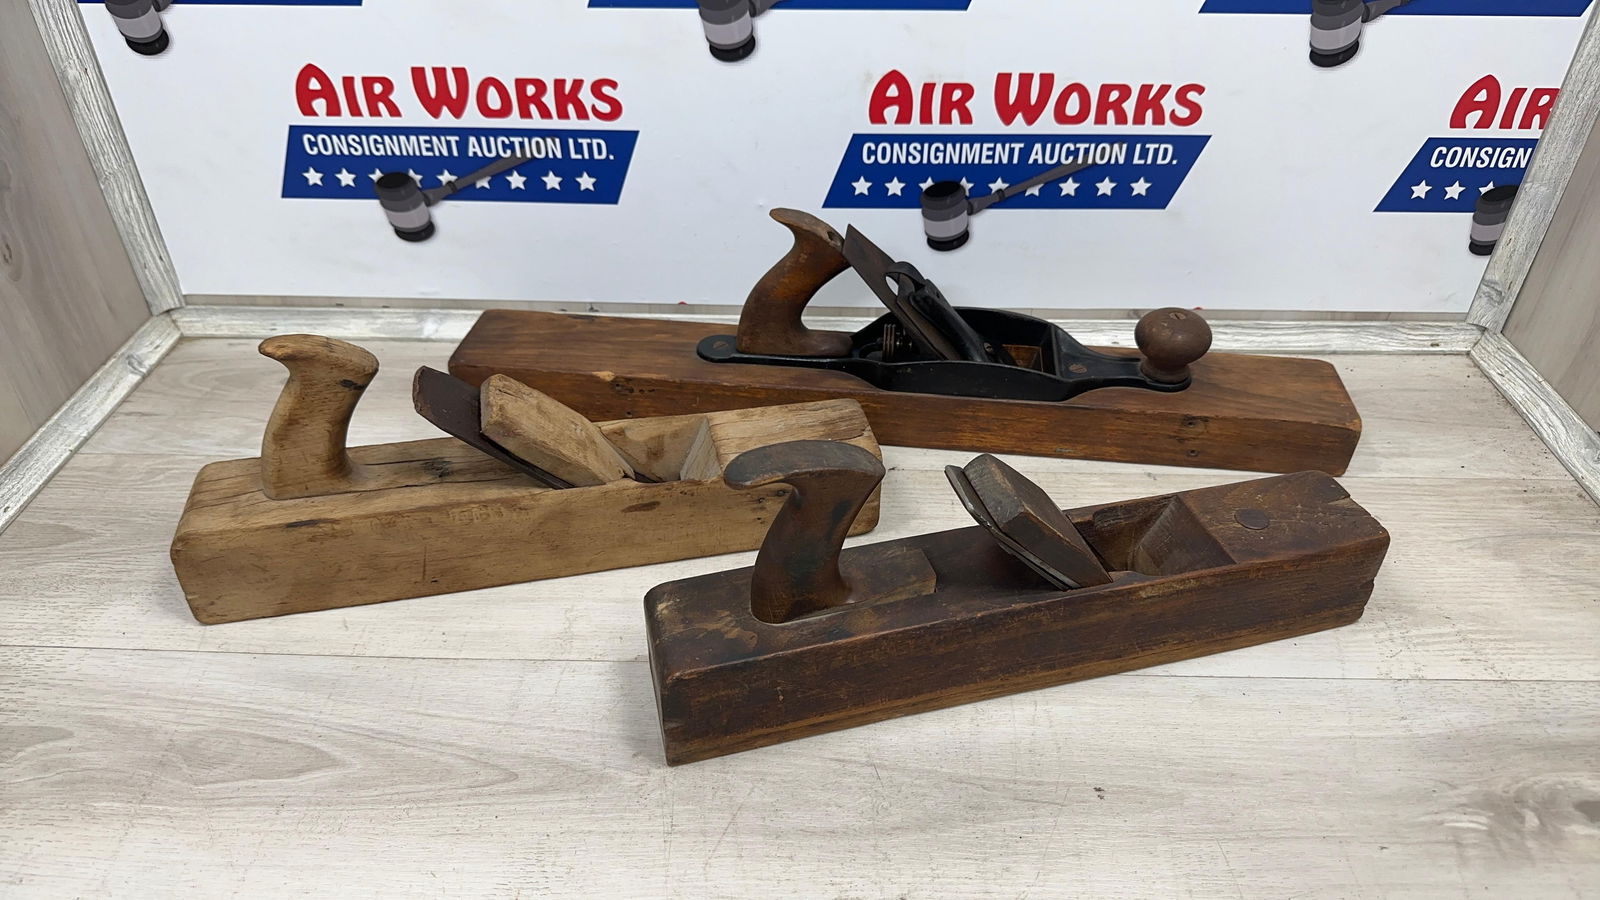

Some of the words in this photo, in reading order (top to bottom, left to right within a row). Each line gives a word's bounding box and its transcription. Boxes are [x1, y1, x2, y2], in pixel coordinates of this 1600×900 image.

[295, 63, 403, 117] AIR
[410, 66, 623, 122] WORKS
[868, 69, 975, 125] AIR
[994, 72, 1206, 127] WORKS
[302, 133, 460, 157] CONSIGNMENT
[467, 135, 562, 159] AUCTION
[568, 137, 615, 161] LTD.
[862, 142, 1025, 165] CONSIGNMENT
[1028, 143, 1127, 165] AUCTION
[1132, 143, 1178, 166] LTD.
